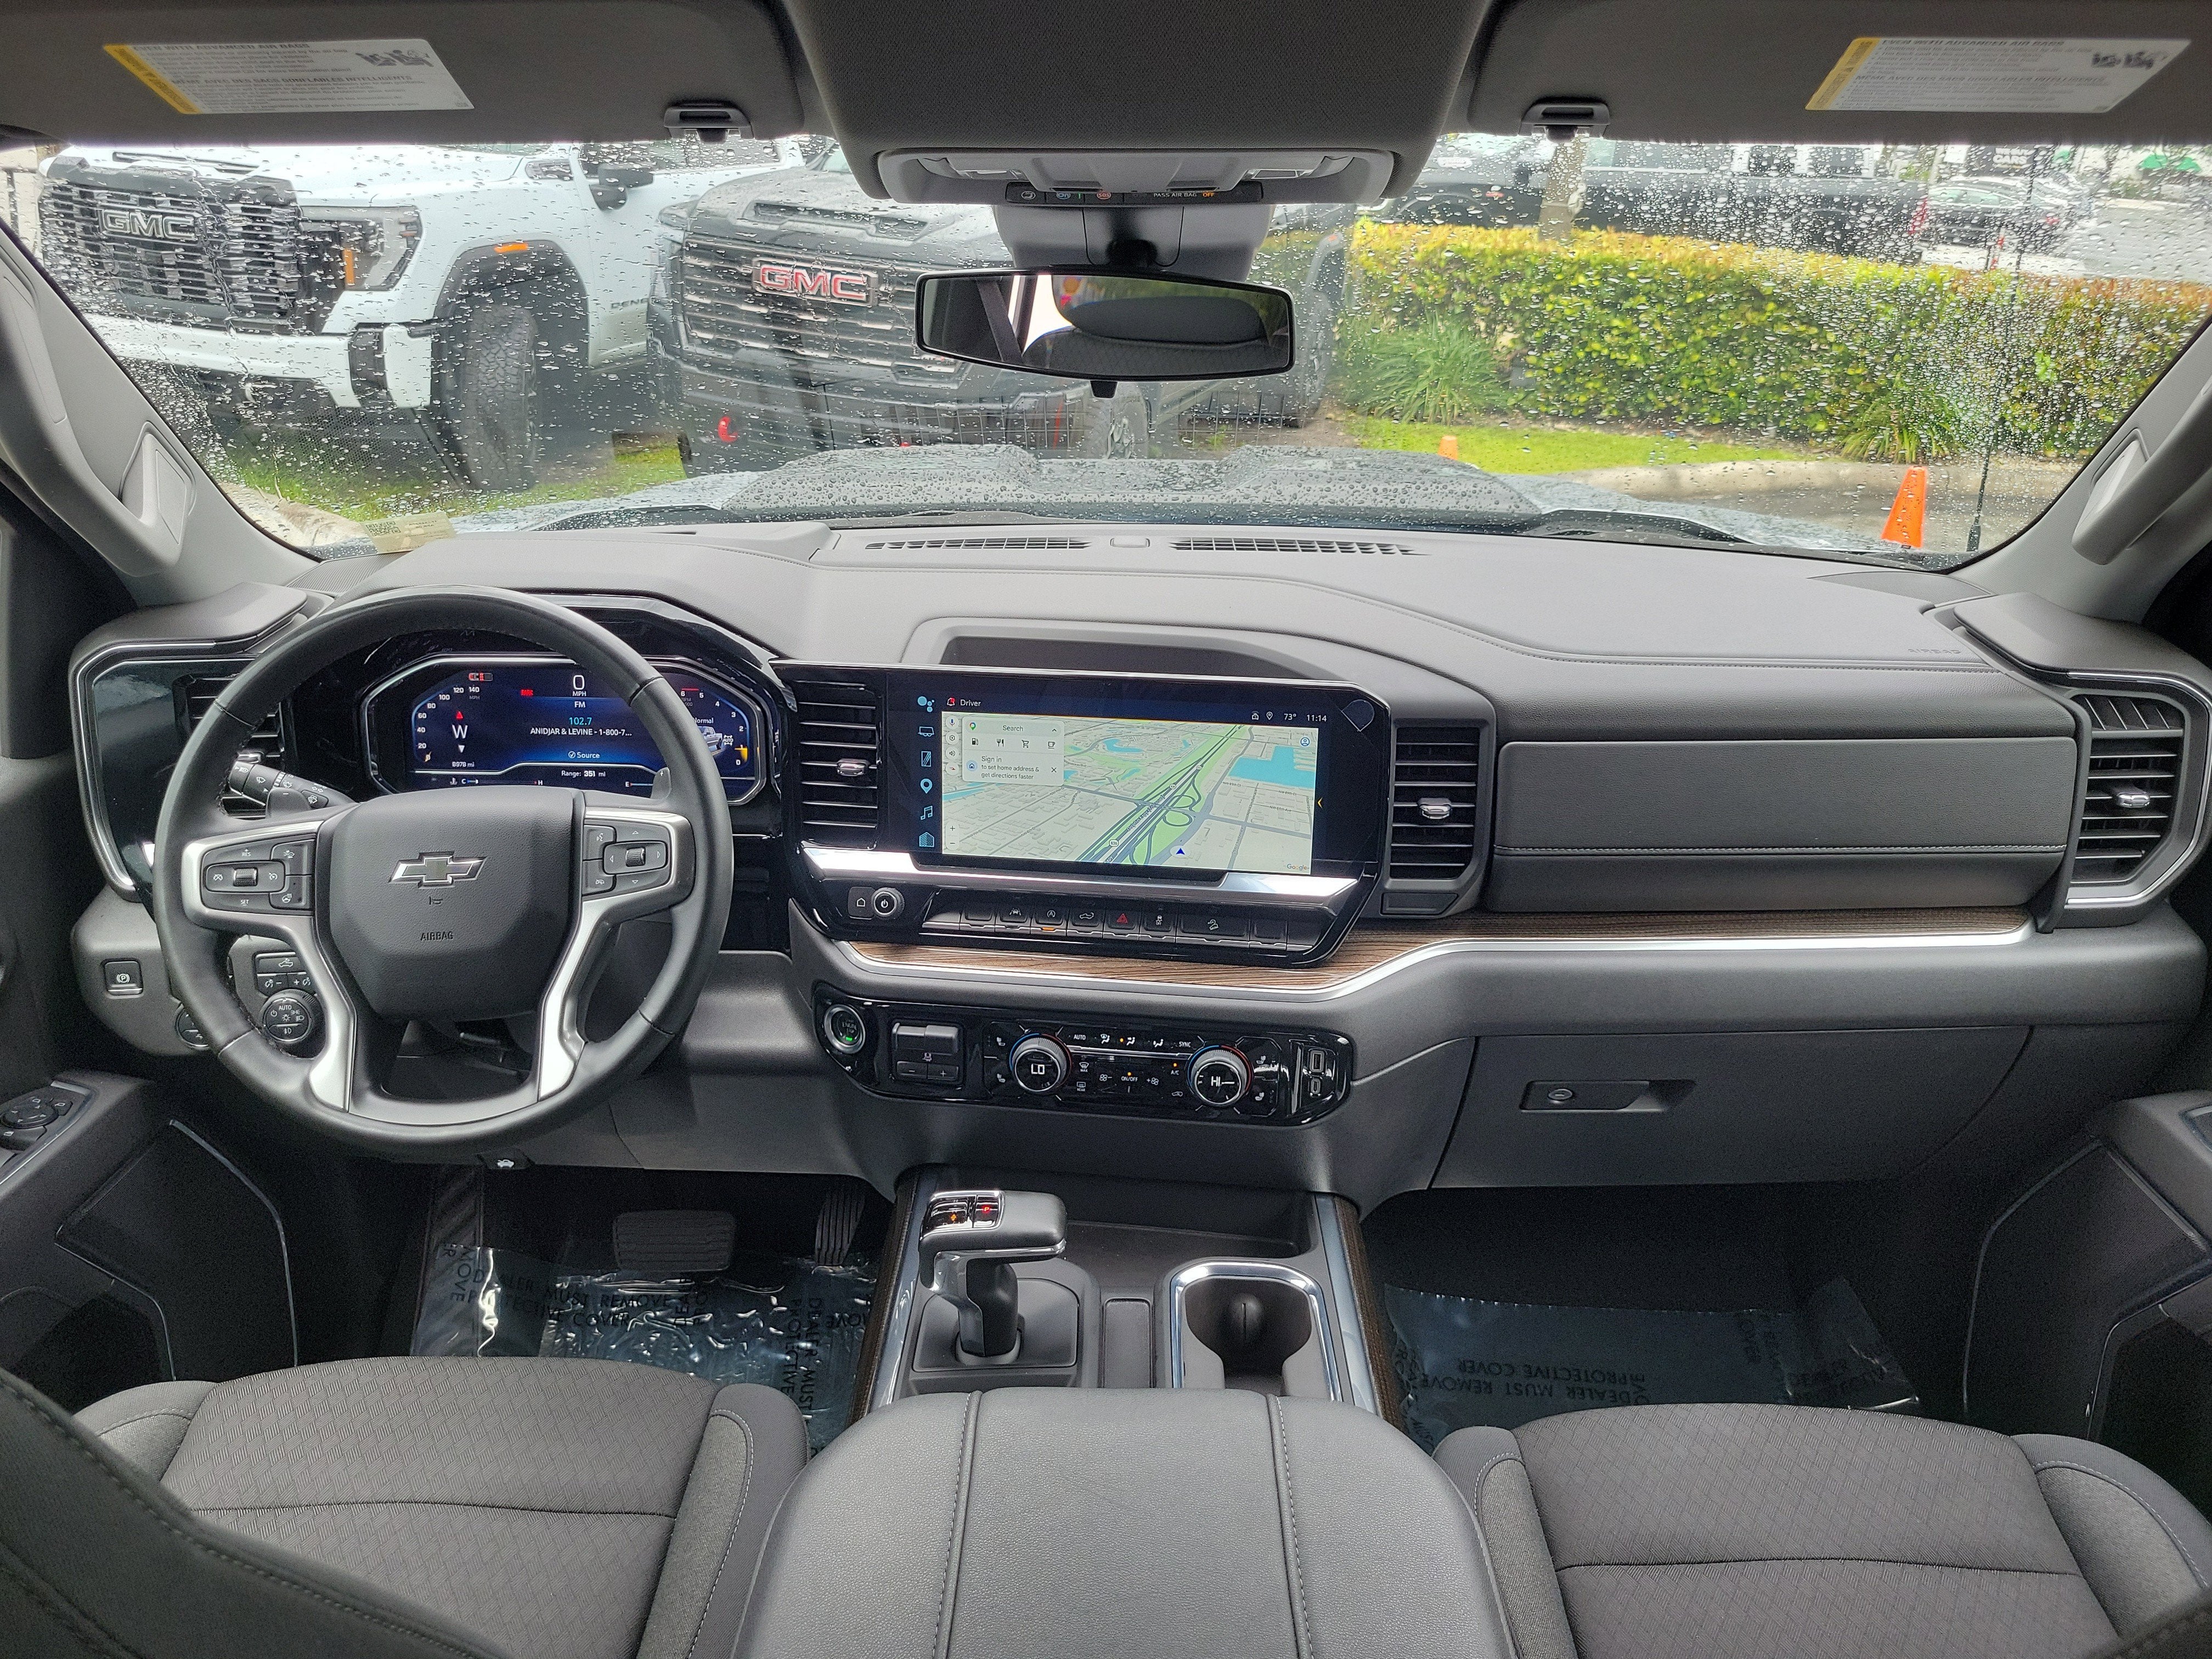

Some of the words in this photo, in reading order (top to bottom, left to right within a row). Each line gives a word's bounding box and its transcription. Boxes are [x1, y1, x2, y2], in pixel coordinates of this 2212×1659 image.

[103, 210, 198, 240] GMC
[760, 266, 867, 301] GMC
[573, 675, 585, 690] 0
[569, 717, 592, 725] 102.7
[452, 724, 468, 739] W
[530, 727, 560, 736] ANIDJAR
[1287, 863, 1307, 871] Google
[420, 931, 453, 941] AIRBAG
[1458, 1358, 1515, 1377] COVER
[1523, 1364, 1628, 1386] PROTECTIVE
[799, 1369, 817, 1410] MUST
[1420, 1373, 1493, 1395] REMOVE
[1505, 1381, 1554, 1398] MUST
[1566, 1385, 1631, 1405] DEALER
